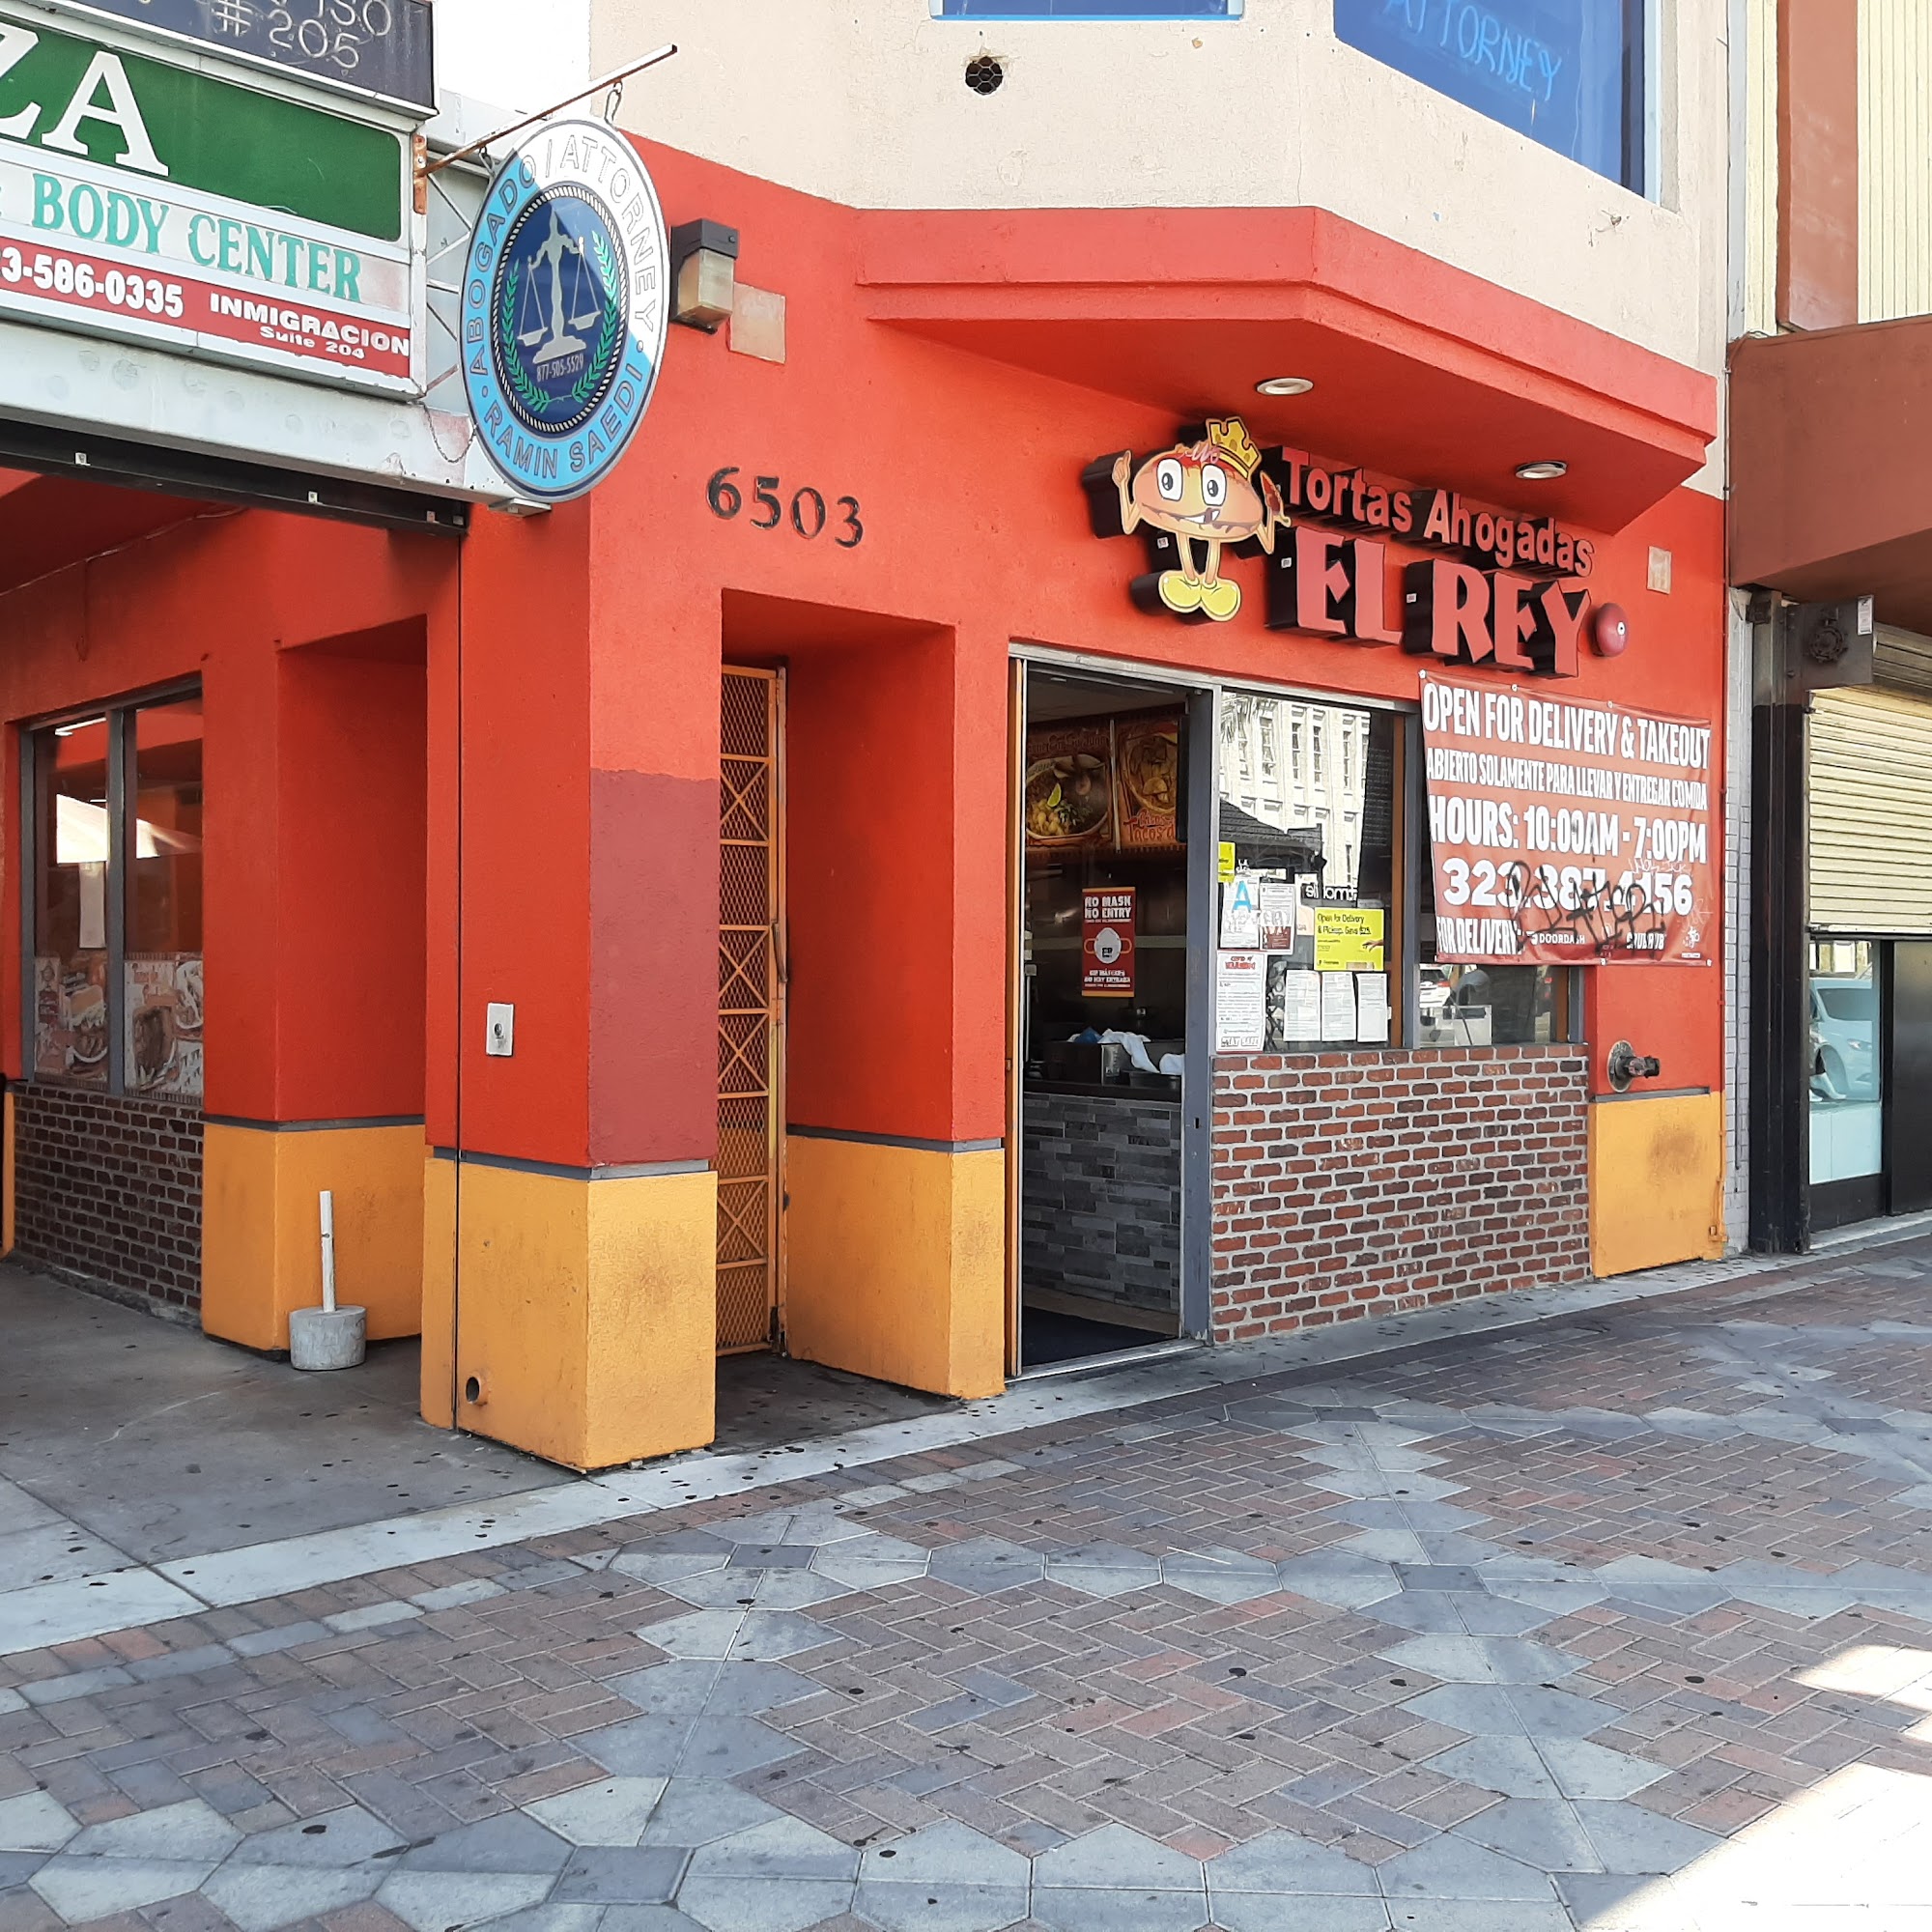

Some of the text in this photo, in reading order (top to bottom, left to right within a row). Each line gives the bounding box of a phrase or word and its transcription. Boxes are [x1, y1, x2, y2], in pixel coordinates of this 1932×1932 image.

[32, 173, 362, 303] BODY CENTER
[468, 154, 536, 376] ABOGADO
[560, 133, 657, 333] ATTORNEY
[210, 292, 410, 356] INMIGRACION
[325, 340, 365, 359] 204
[484, 362, 643, 479] RAMIN SAEDI
[706, 466, 865, 549] 6503
[1281, 445, 1595, 578] Tortas Ahogadas
[1295, 526, 1592, 678] EL REY
[1423, 683, 1710, 770] OPEN FOR DELIVERY & TAKEOUT
[1427, 748, 1478, 784] ABIERTO
[1479, 753, 1546, 792] SOLAMENTE
[1547, 761, 1576, 796] PARA
[1577, 766, 1612, 800] LLEVAR
[1612, 771, 1622, 801] Y
[1623, 774, 1671, 808] ENTREGAR
[1429, 795, 1519, 848] HOURS:
[1522, 804, 1618, 857] 10:00AM
[1634, 816, 1707, 865] 7:00PM
[1102, 907, 1131, 918] ENTRY
[1232, 880, 1253, 914] A
